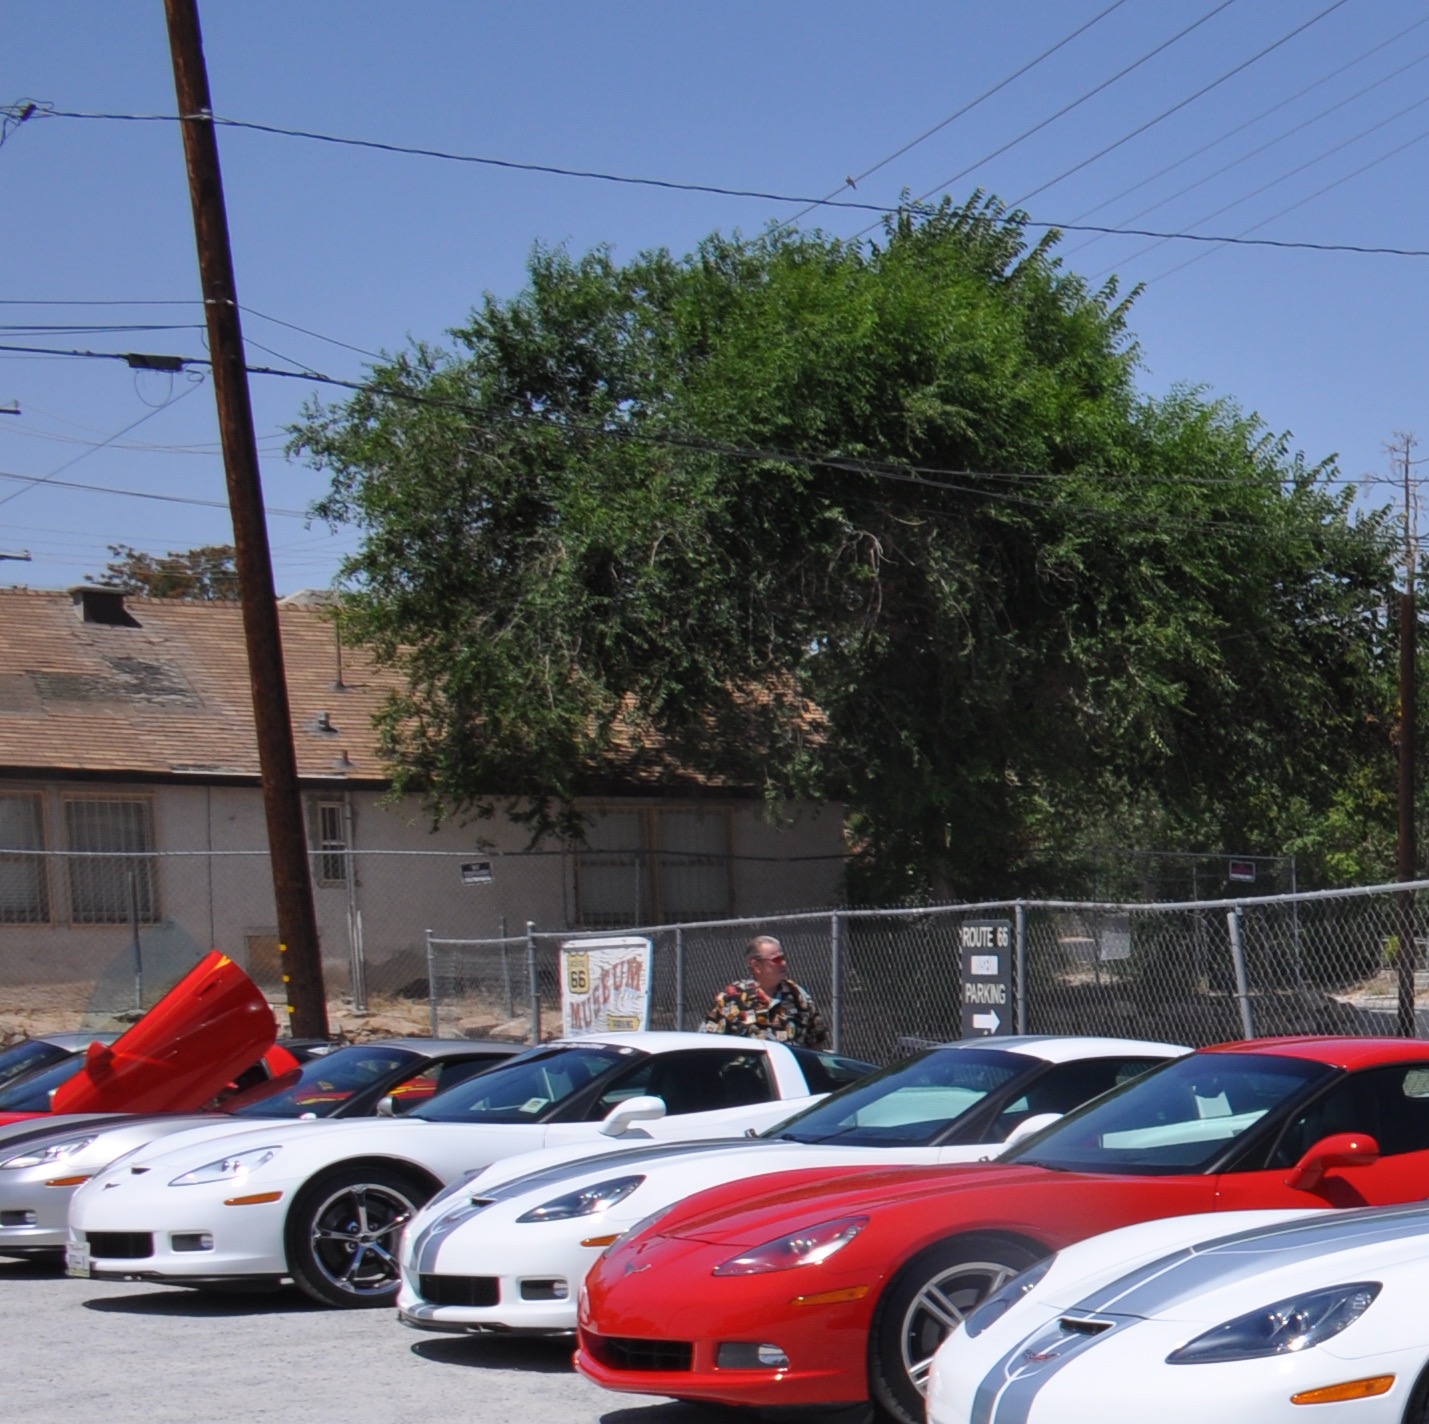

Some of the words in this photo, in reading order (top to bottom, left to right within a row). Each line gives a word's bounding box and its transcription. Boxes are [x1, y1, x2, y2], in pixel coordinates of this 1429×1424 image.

[963, 927, 994, 948] ROUTE
[997, 926, 1009, 948] 66
[570, 969, 587, 989] 66
[569, 956, 644, 1030] MUSEUM
[965, 983, 1006, 1004] PARKING
